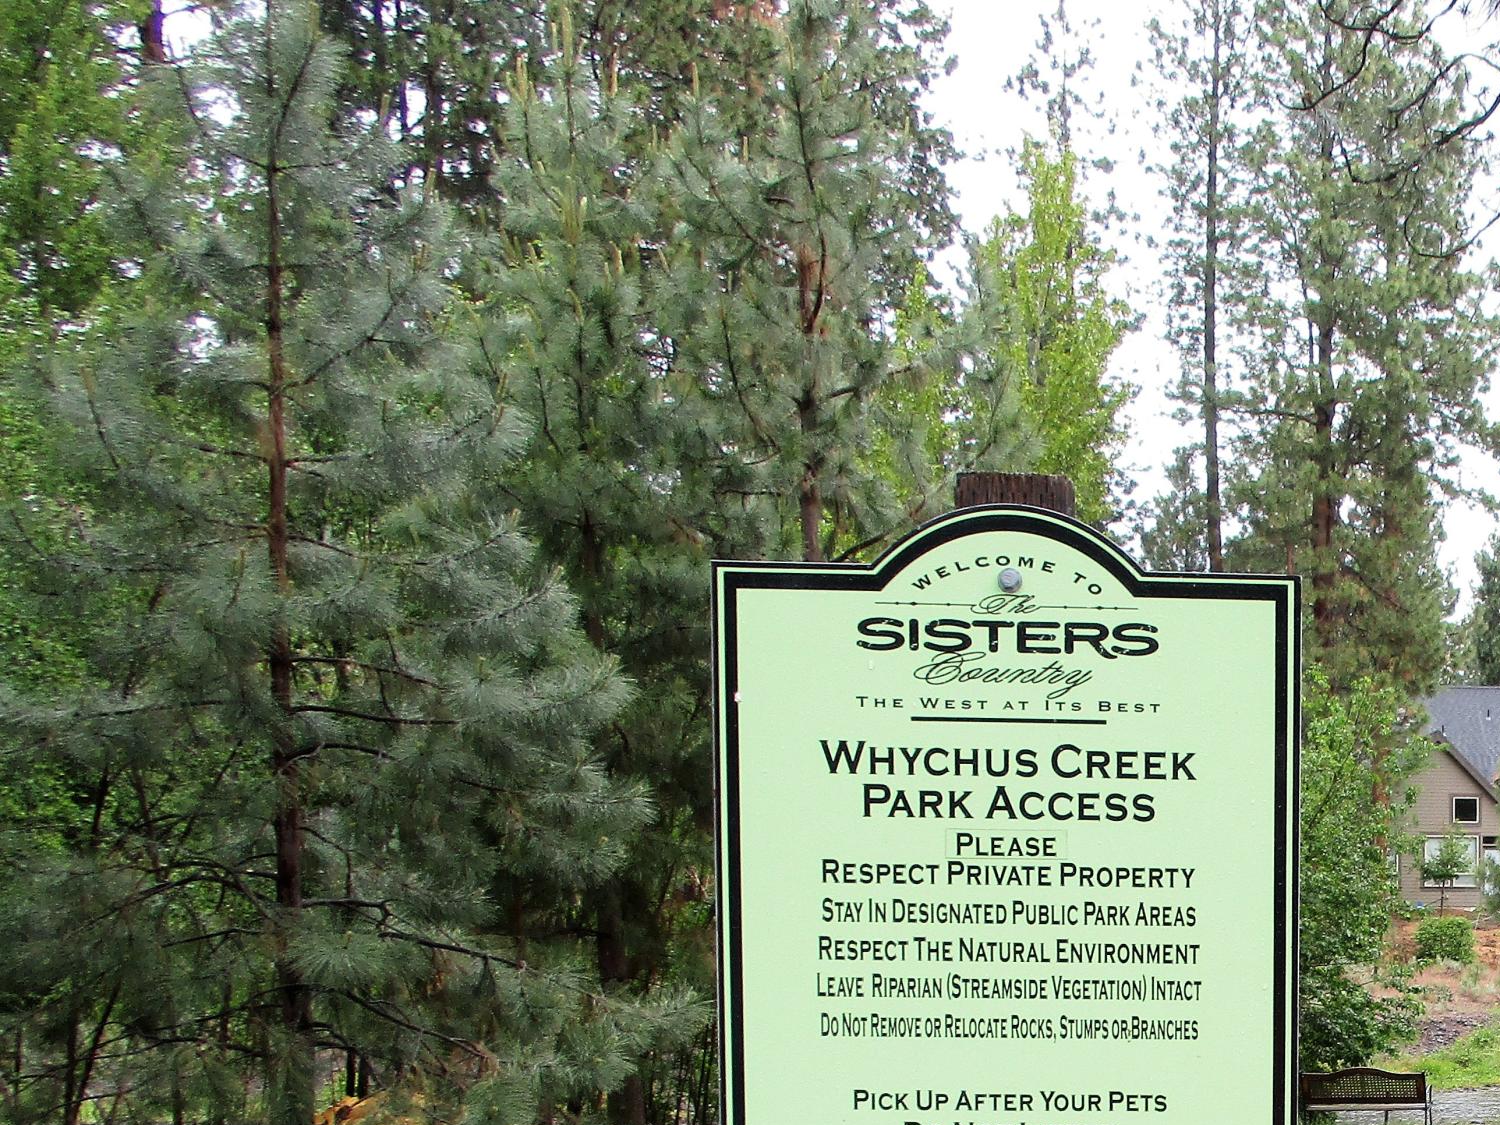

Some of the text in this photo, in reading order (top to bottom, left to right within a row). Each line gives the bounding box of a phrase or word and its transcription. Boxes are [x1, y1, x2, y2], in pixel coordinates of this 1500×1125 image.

[911, 555, 1102, 595] WELCOME TO
[971, 594, 1039, 615] The
[857, 617, 1159, 659] SISTERS
[914, 652, 1094, 699] Country
